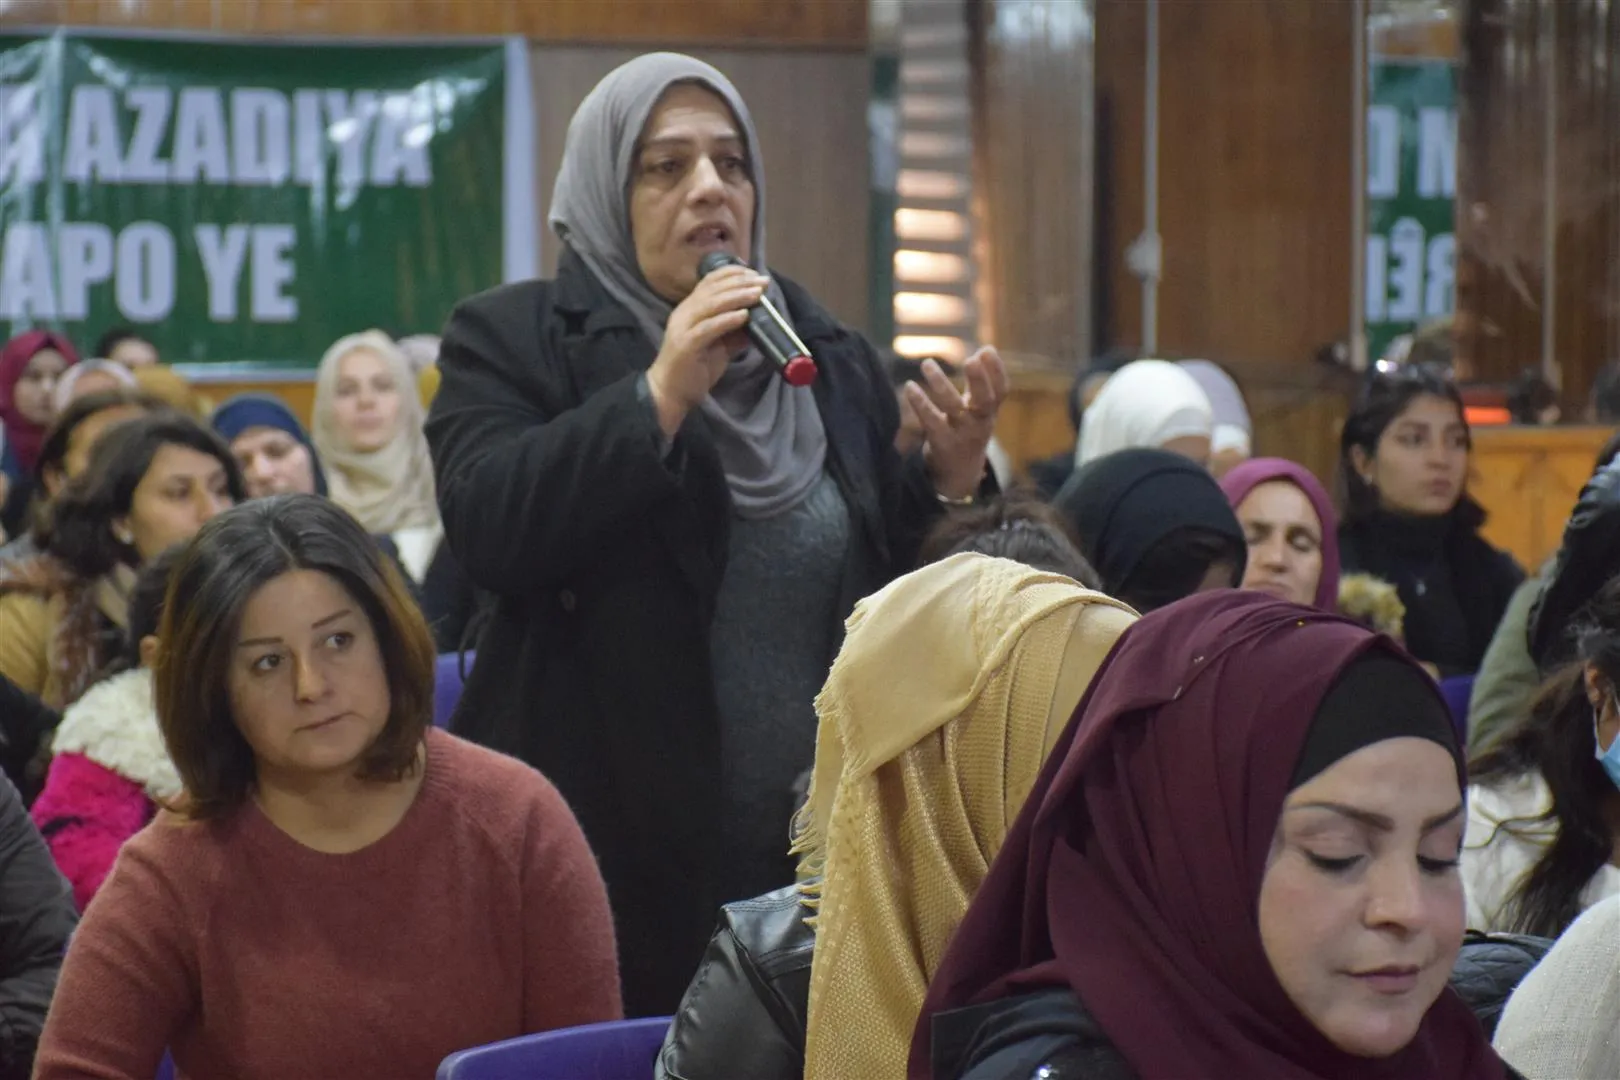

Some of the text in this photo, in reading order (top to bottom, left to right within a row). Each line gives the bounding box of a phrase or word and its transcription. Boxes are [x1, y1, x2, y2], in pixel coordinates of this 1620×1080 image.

[64, 84, 432, 187] AZADIYA
[0, 220, 299, 323] APO YE
